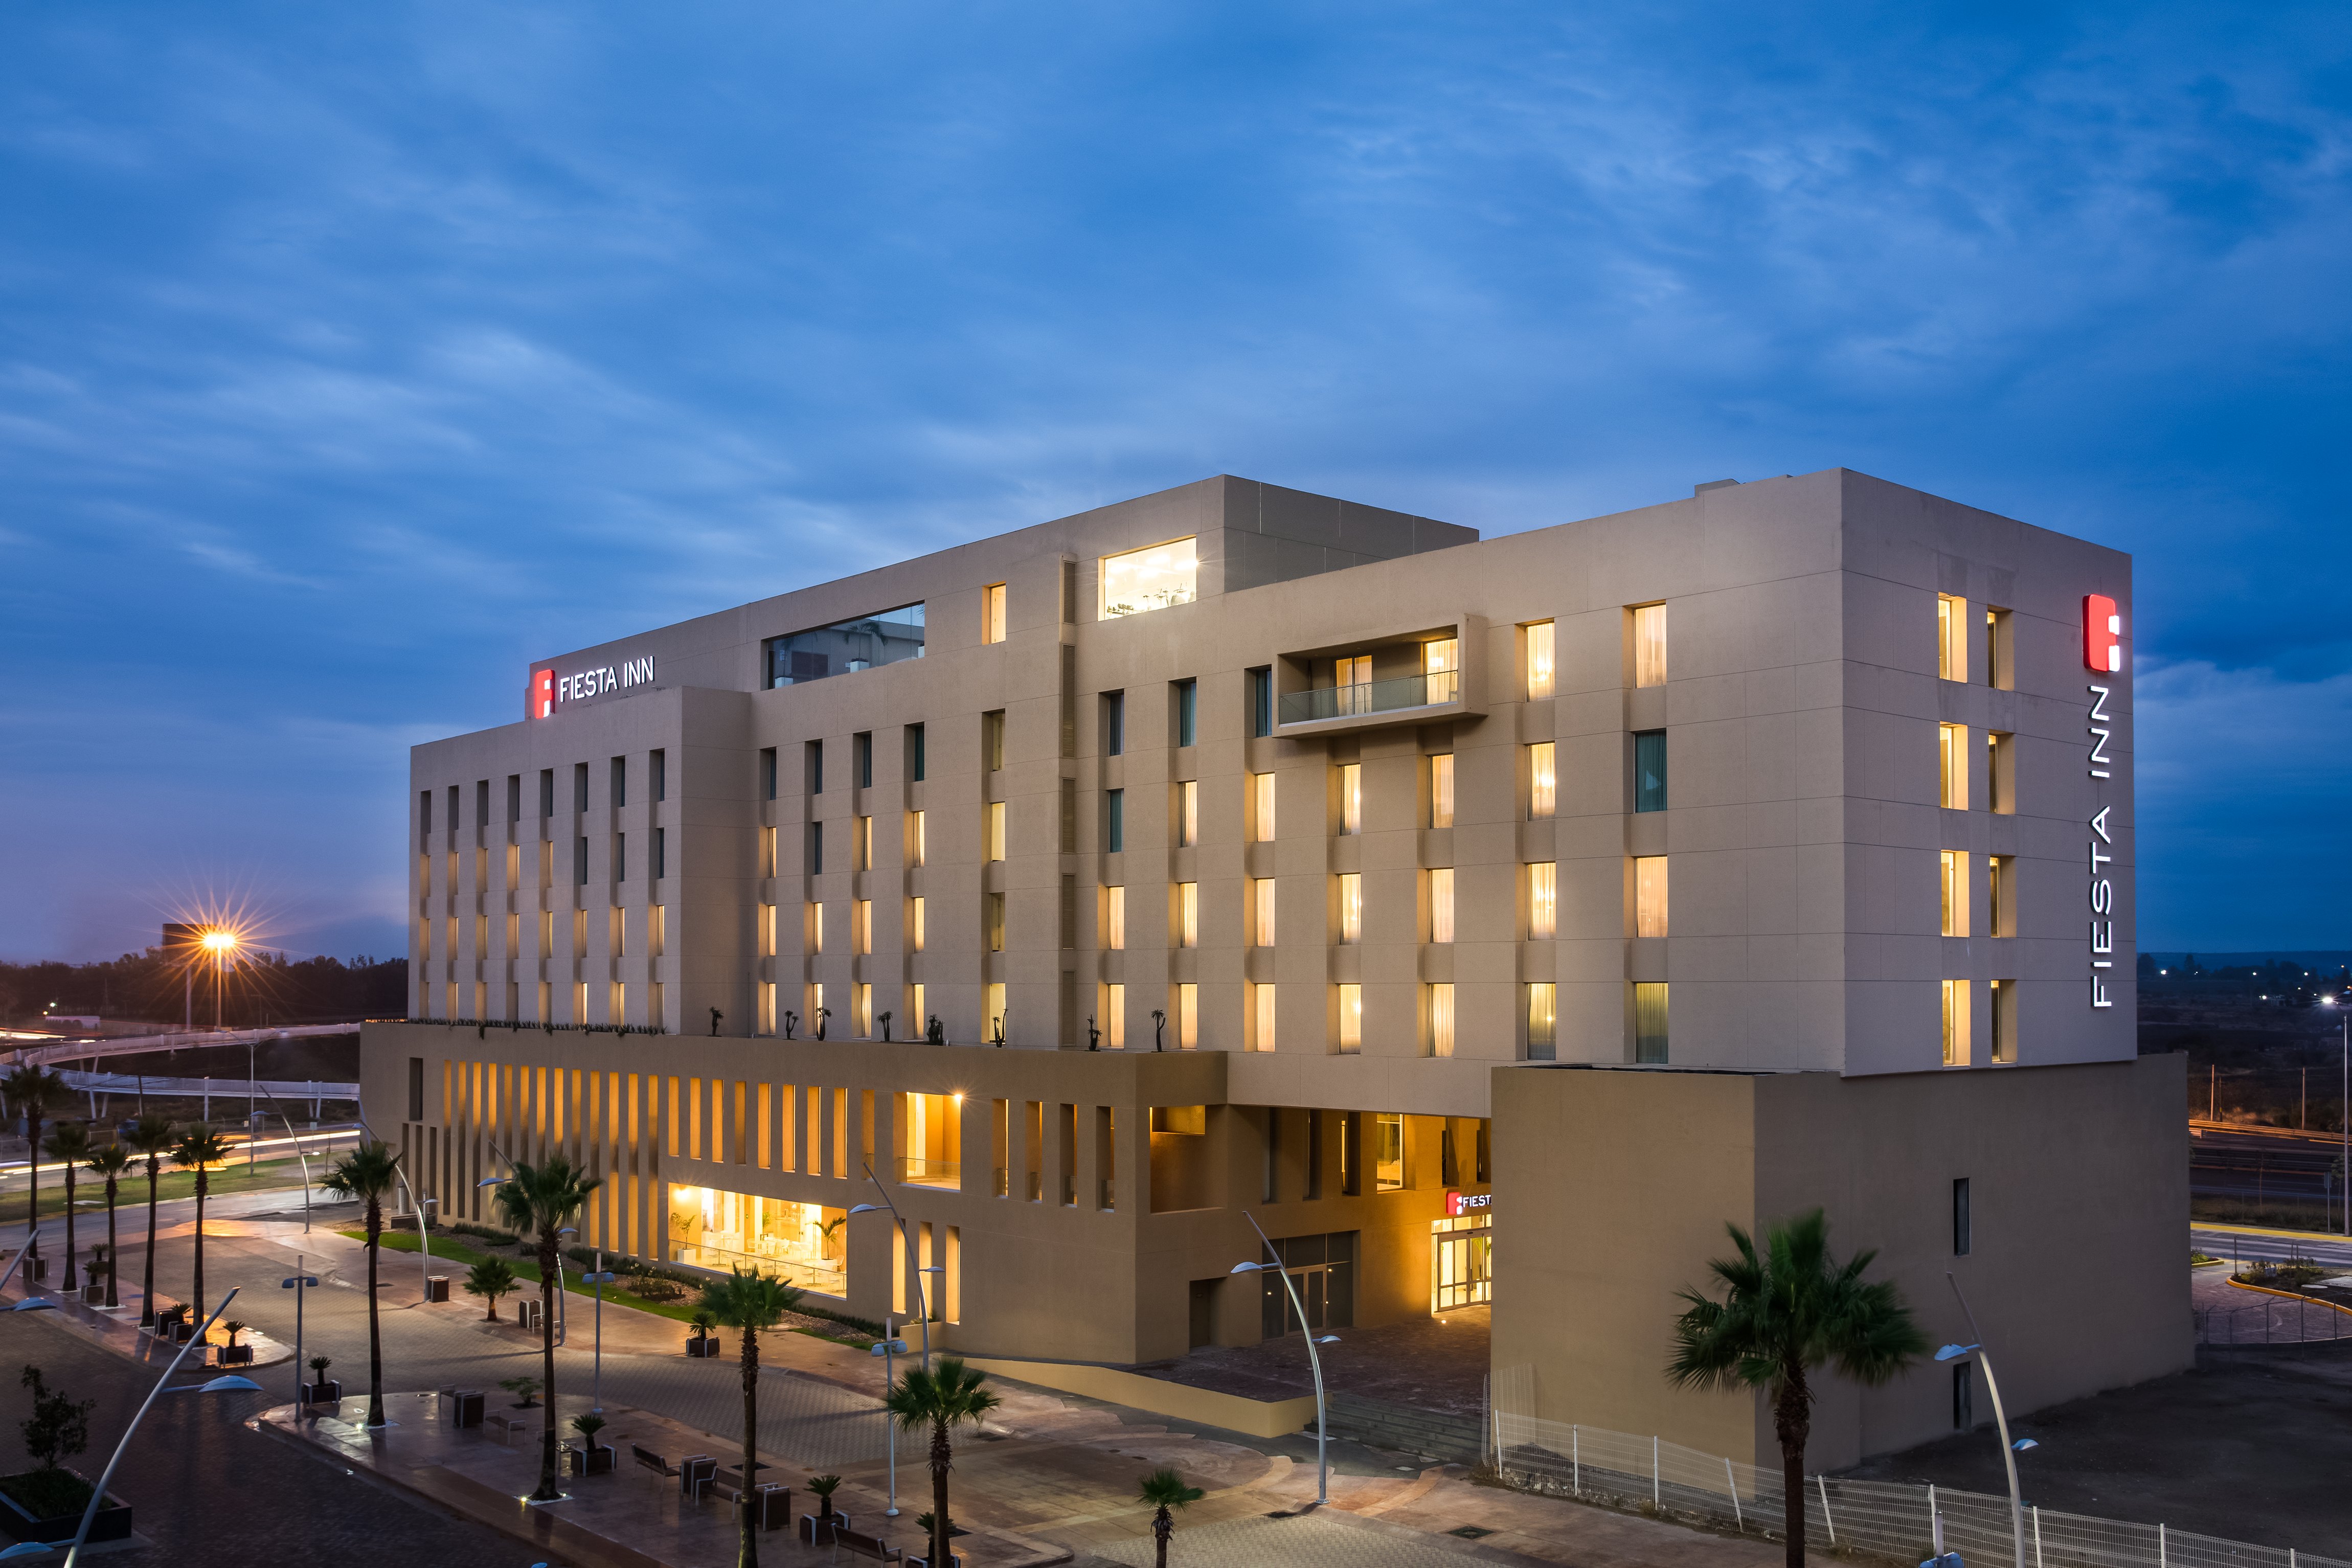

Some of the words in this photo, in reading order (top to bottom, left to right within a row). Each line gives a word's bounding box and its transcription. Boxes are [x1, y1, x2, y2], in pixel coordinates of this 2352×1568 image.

[560, 666, 618, 702] FIESTA
[624, 655, 654, 688] INN
[2090, 685, 2110, 778] INN
[2090, 805, 2112, 1007] FIESTA
[1463, 1194, 1492, 1208] FIEST
